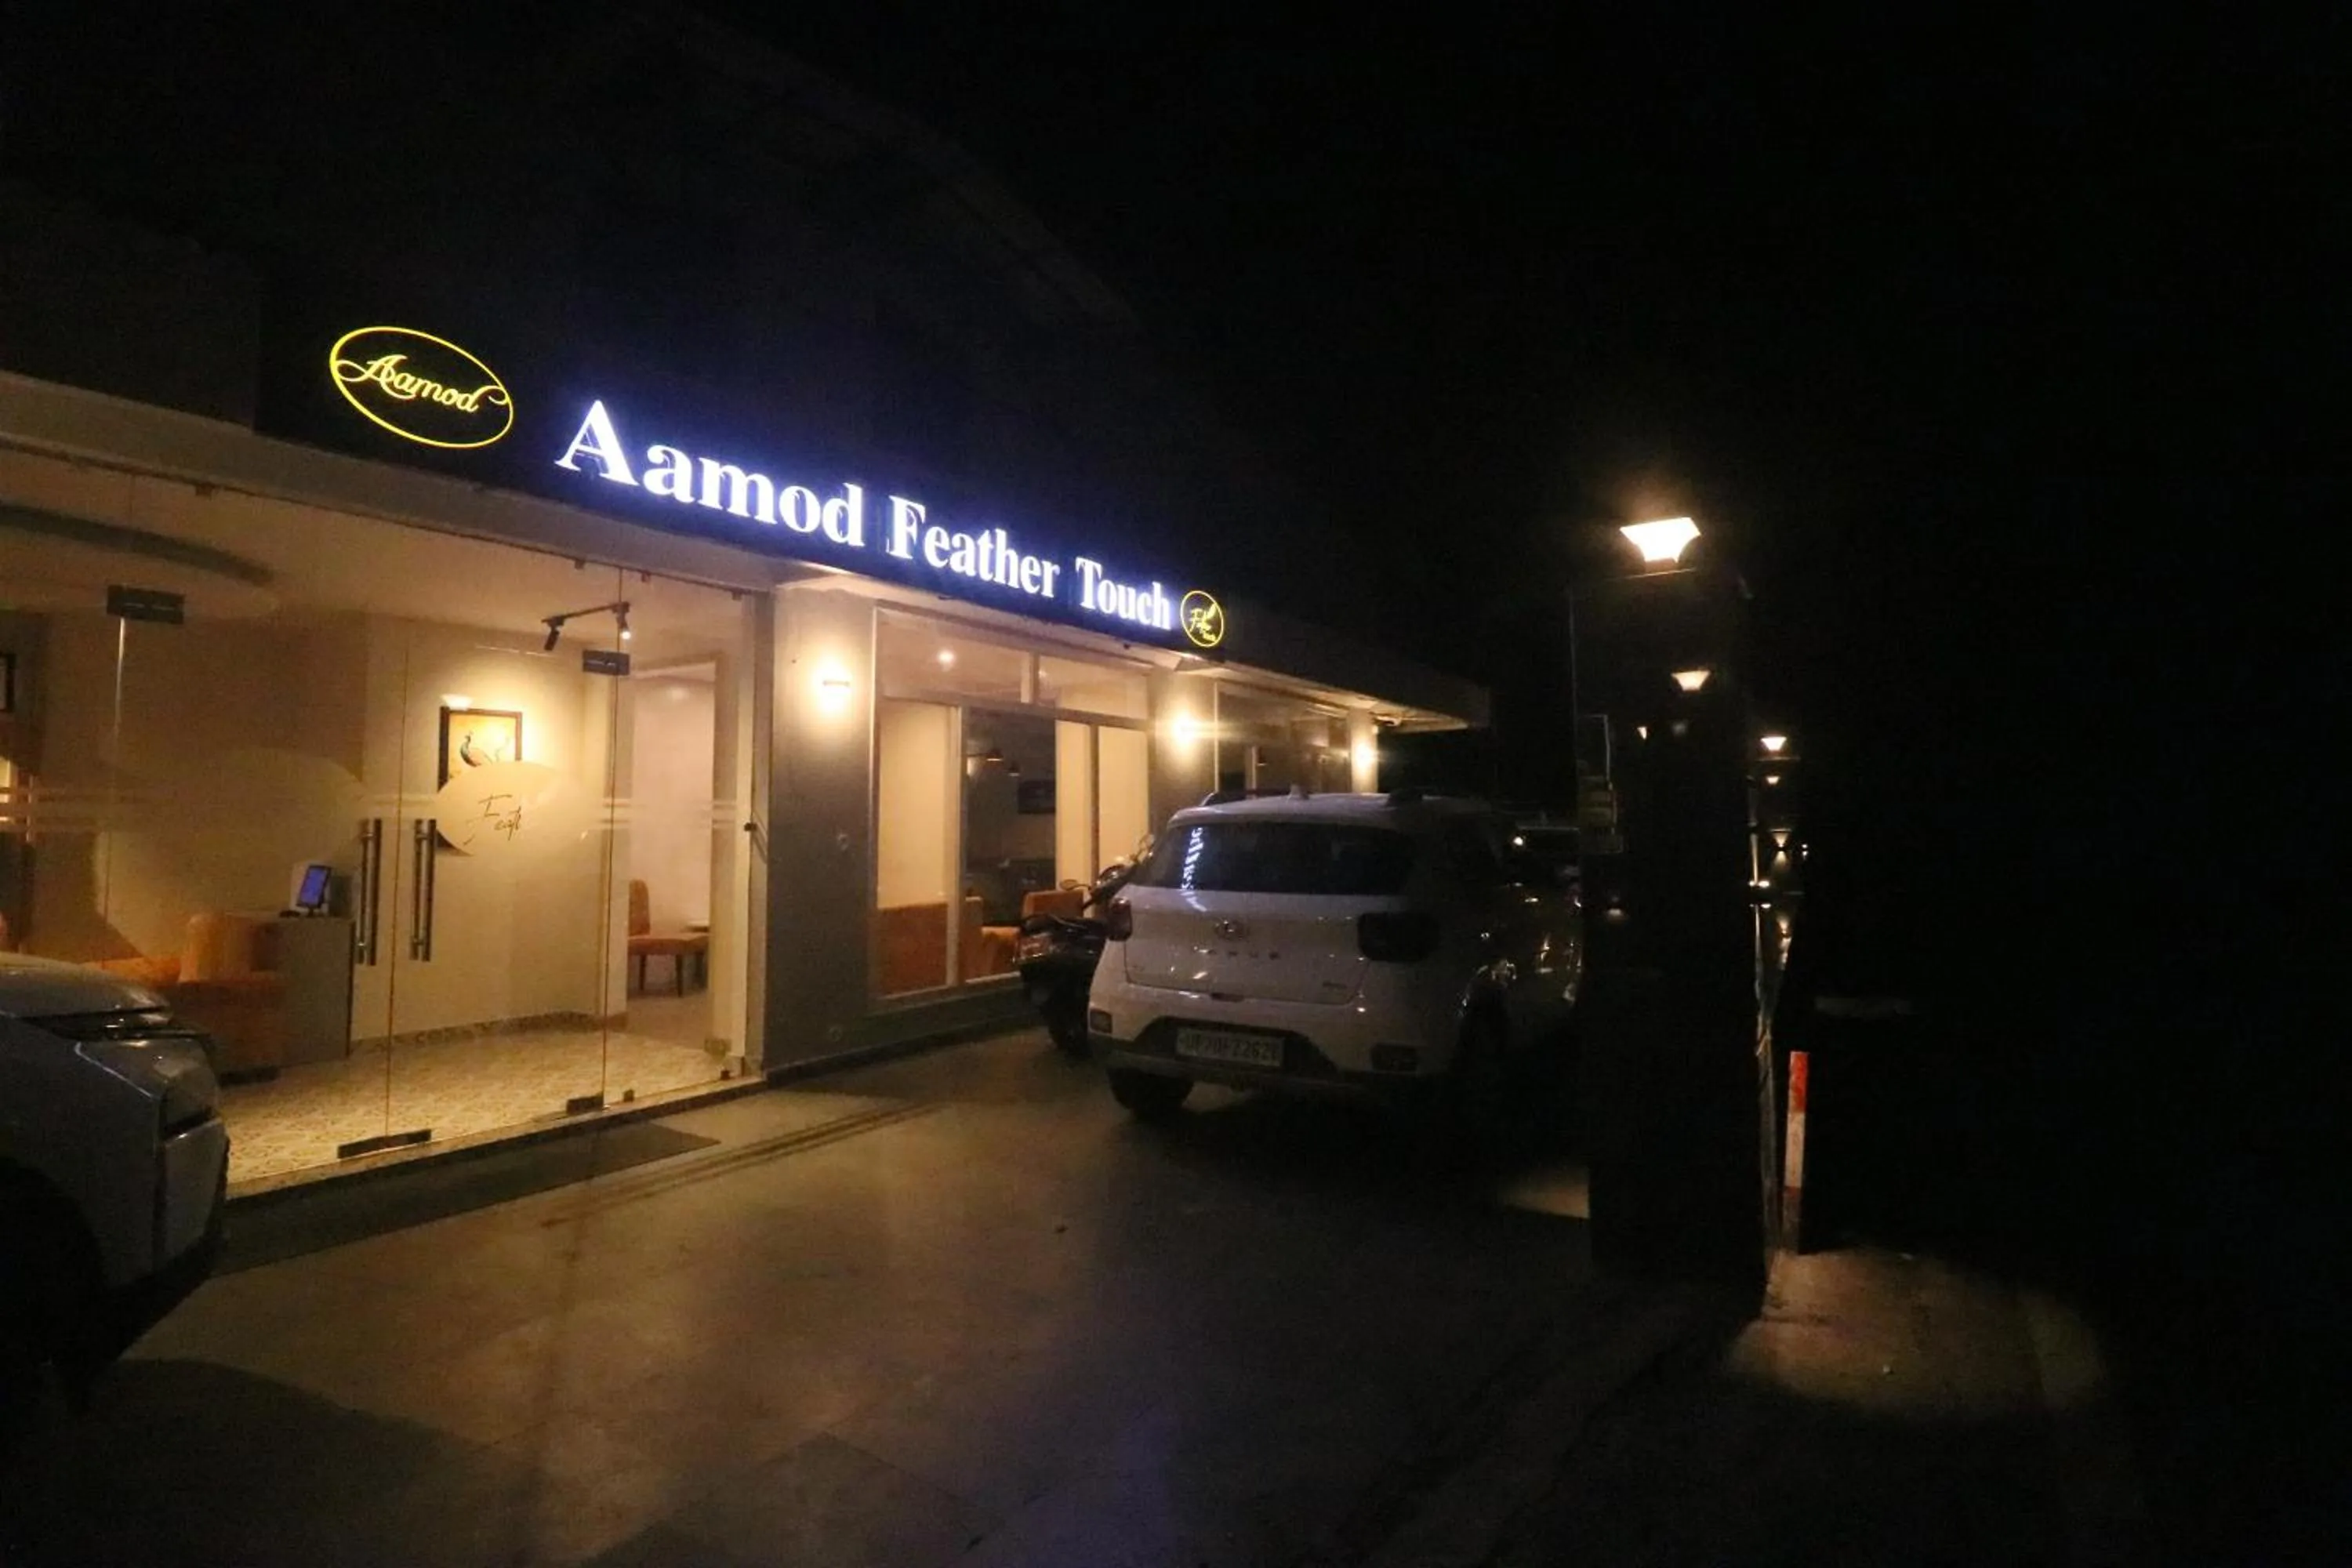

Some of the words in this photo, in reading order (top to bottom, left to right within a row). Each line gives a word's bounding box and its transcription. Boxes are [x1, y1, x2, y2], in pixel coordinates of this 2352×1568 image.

[336, 354, 510, 412] Aamod
[555, 400, 866, 547] Aamod
[886, 495, 1061, 598] Feather
[1075, 556, 1172, 630] Touch
